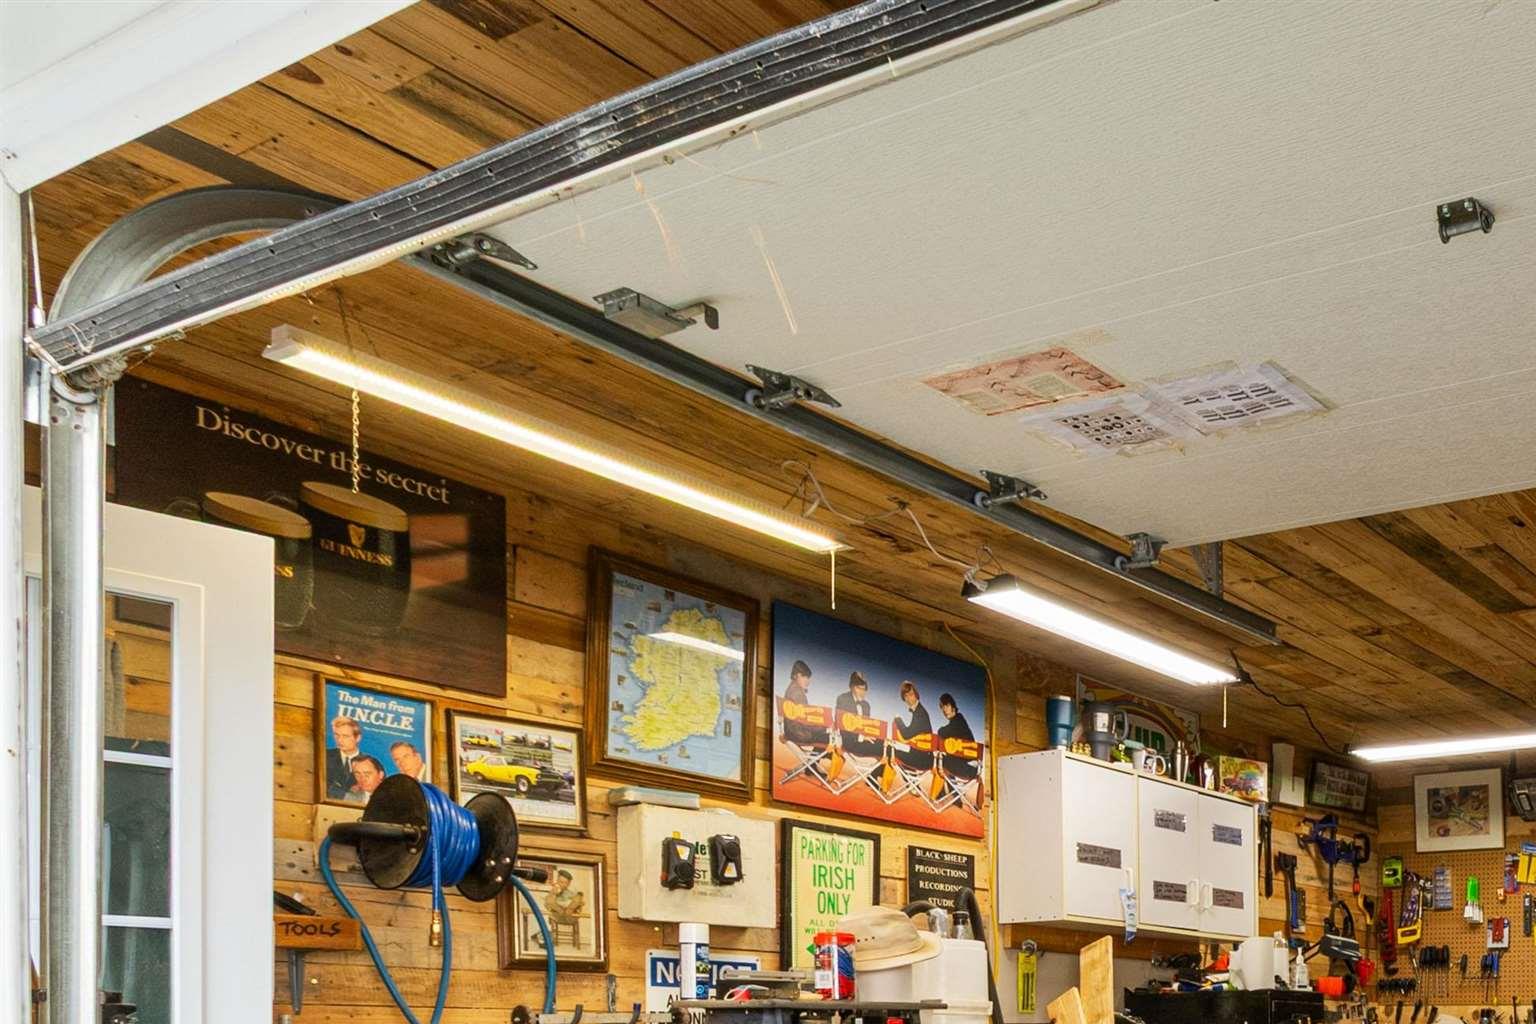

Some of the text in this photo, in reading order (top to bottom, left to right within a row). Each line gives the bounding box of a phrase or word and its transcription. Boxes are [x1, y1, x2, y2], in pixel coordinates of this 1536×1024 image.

[196, 406, 450, 504] Discover the secret
[337, 691, 416, 714] The Man from
[801, 836, 865, 866] PARKING FOR
[915, 849, 968, 863] BLACK SHEEP
[813, 864, 855, 891] IRISH
[915, 864, 968, 879] PRODUCTIONS
[817, 891, 851, 916] ONLY
[928, 897, 955, 907] STUDI
[278, 922, 341, 937] TOOLS
